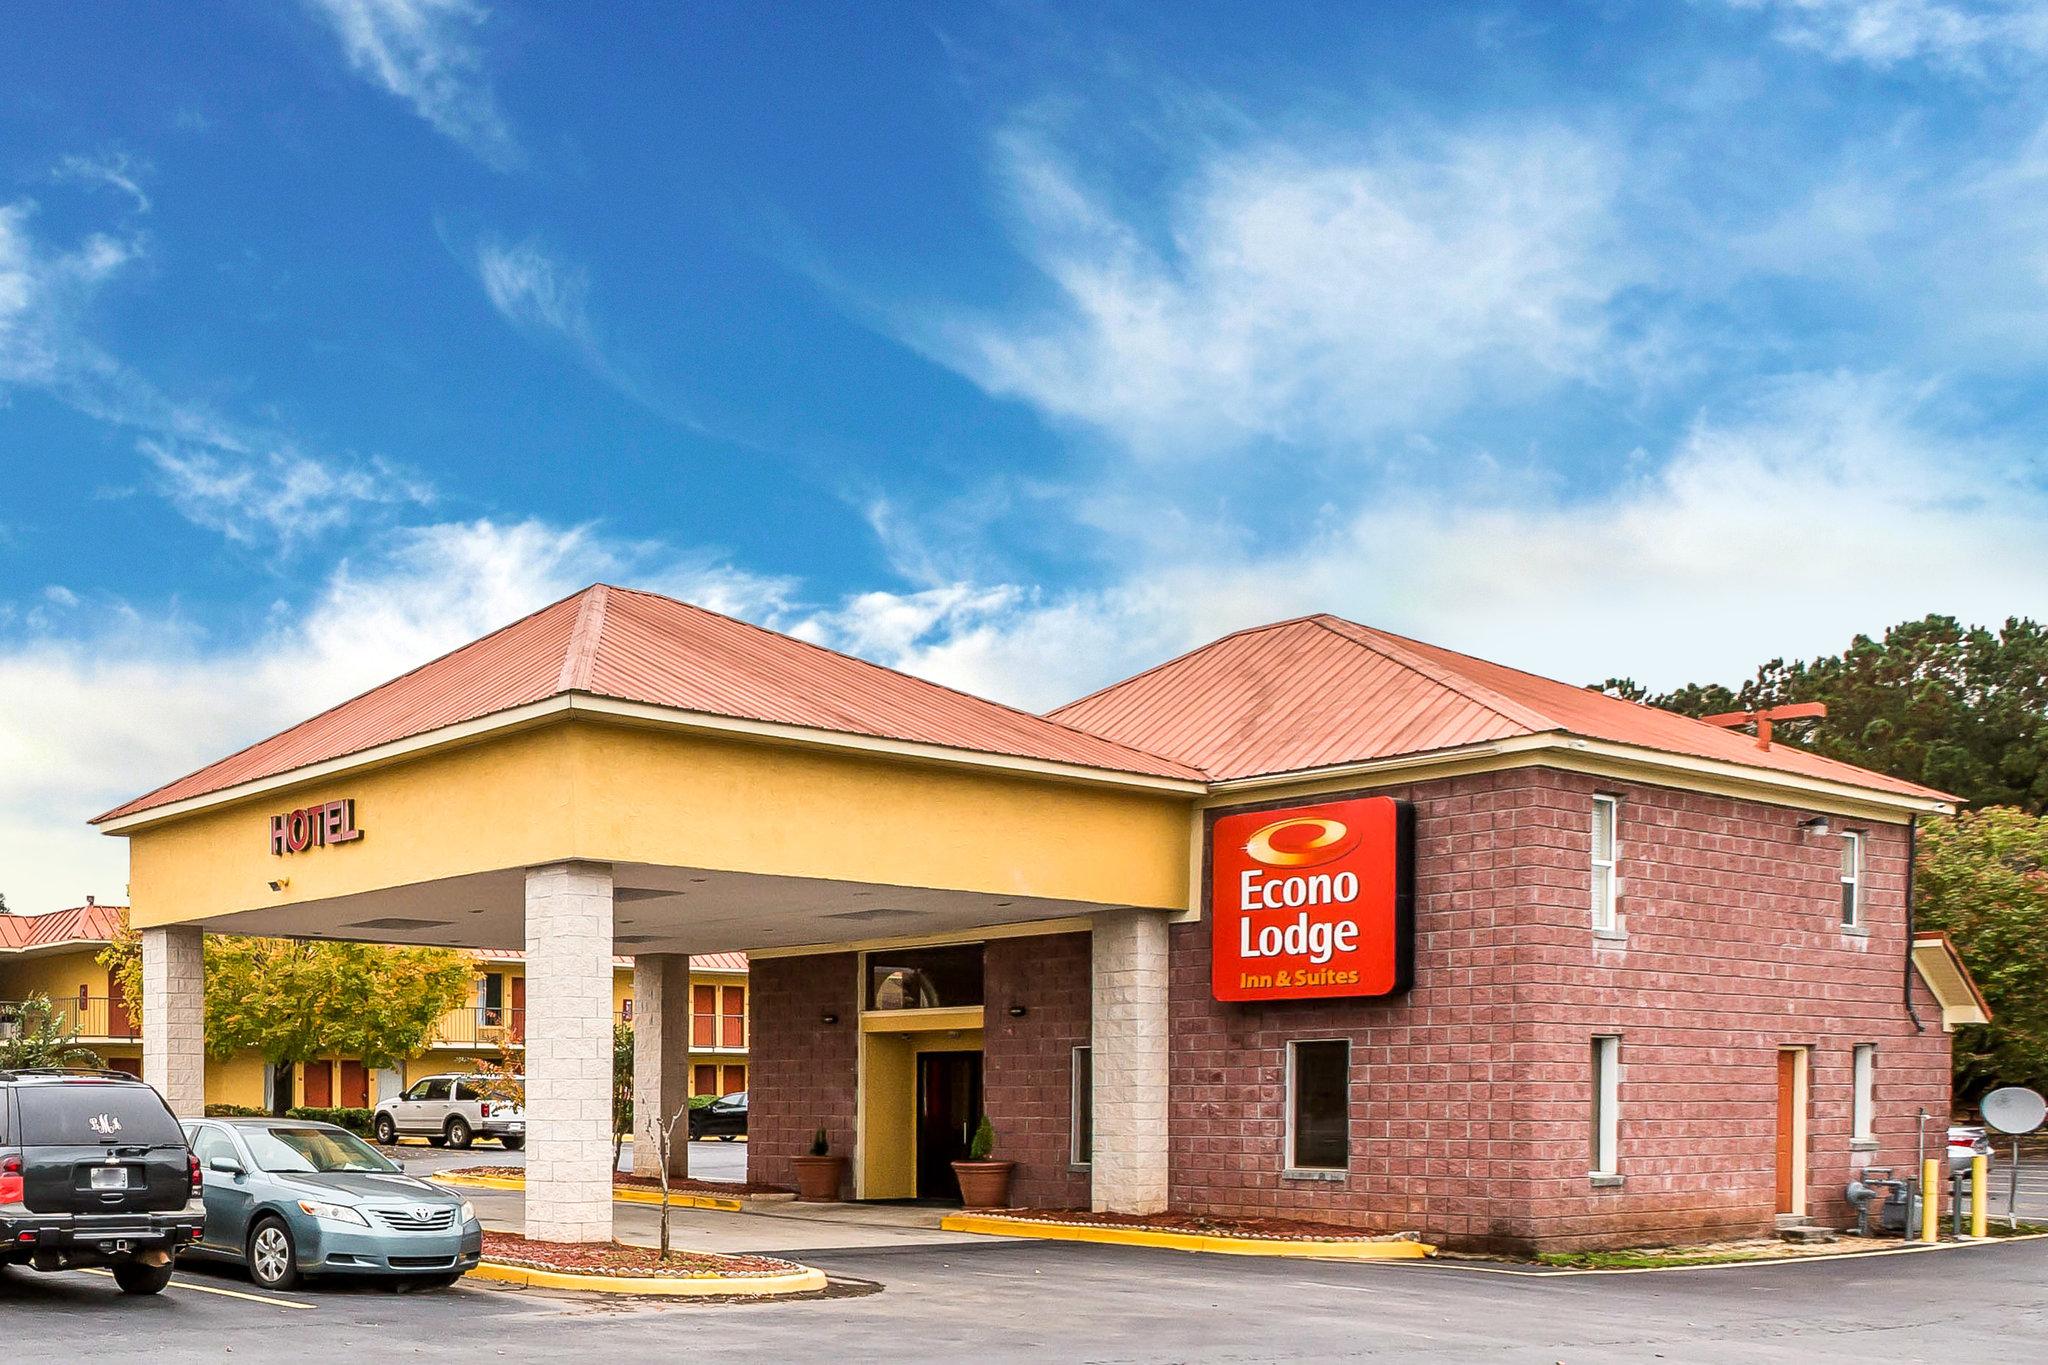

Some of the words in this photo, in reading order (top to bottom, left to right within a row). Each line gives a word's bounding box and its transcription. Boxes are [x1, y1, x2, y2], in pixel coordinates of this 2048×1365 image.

[270, 799, 362, 855] HOTEL
[1240, 869, 1359, 911] Econo
[1240, 912, 1359, 964] Lodge
[1240, 972, 1272, 988] Inn
[1275, 970, 1292, 987] &
[1294, 968, 1359, 987] Suites
